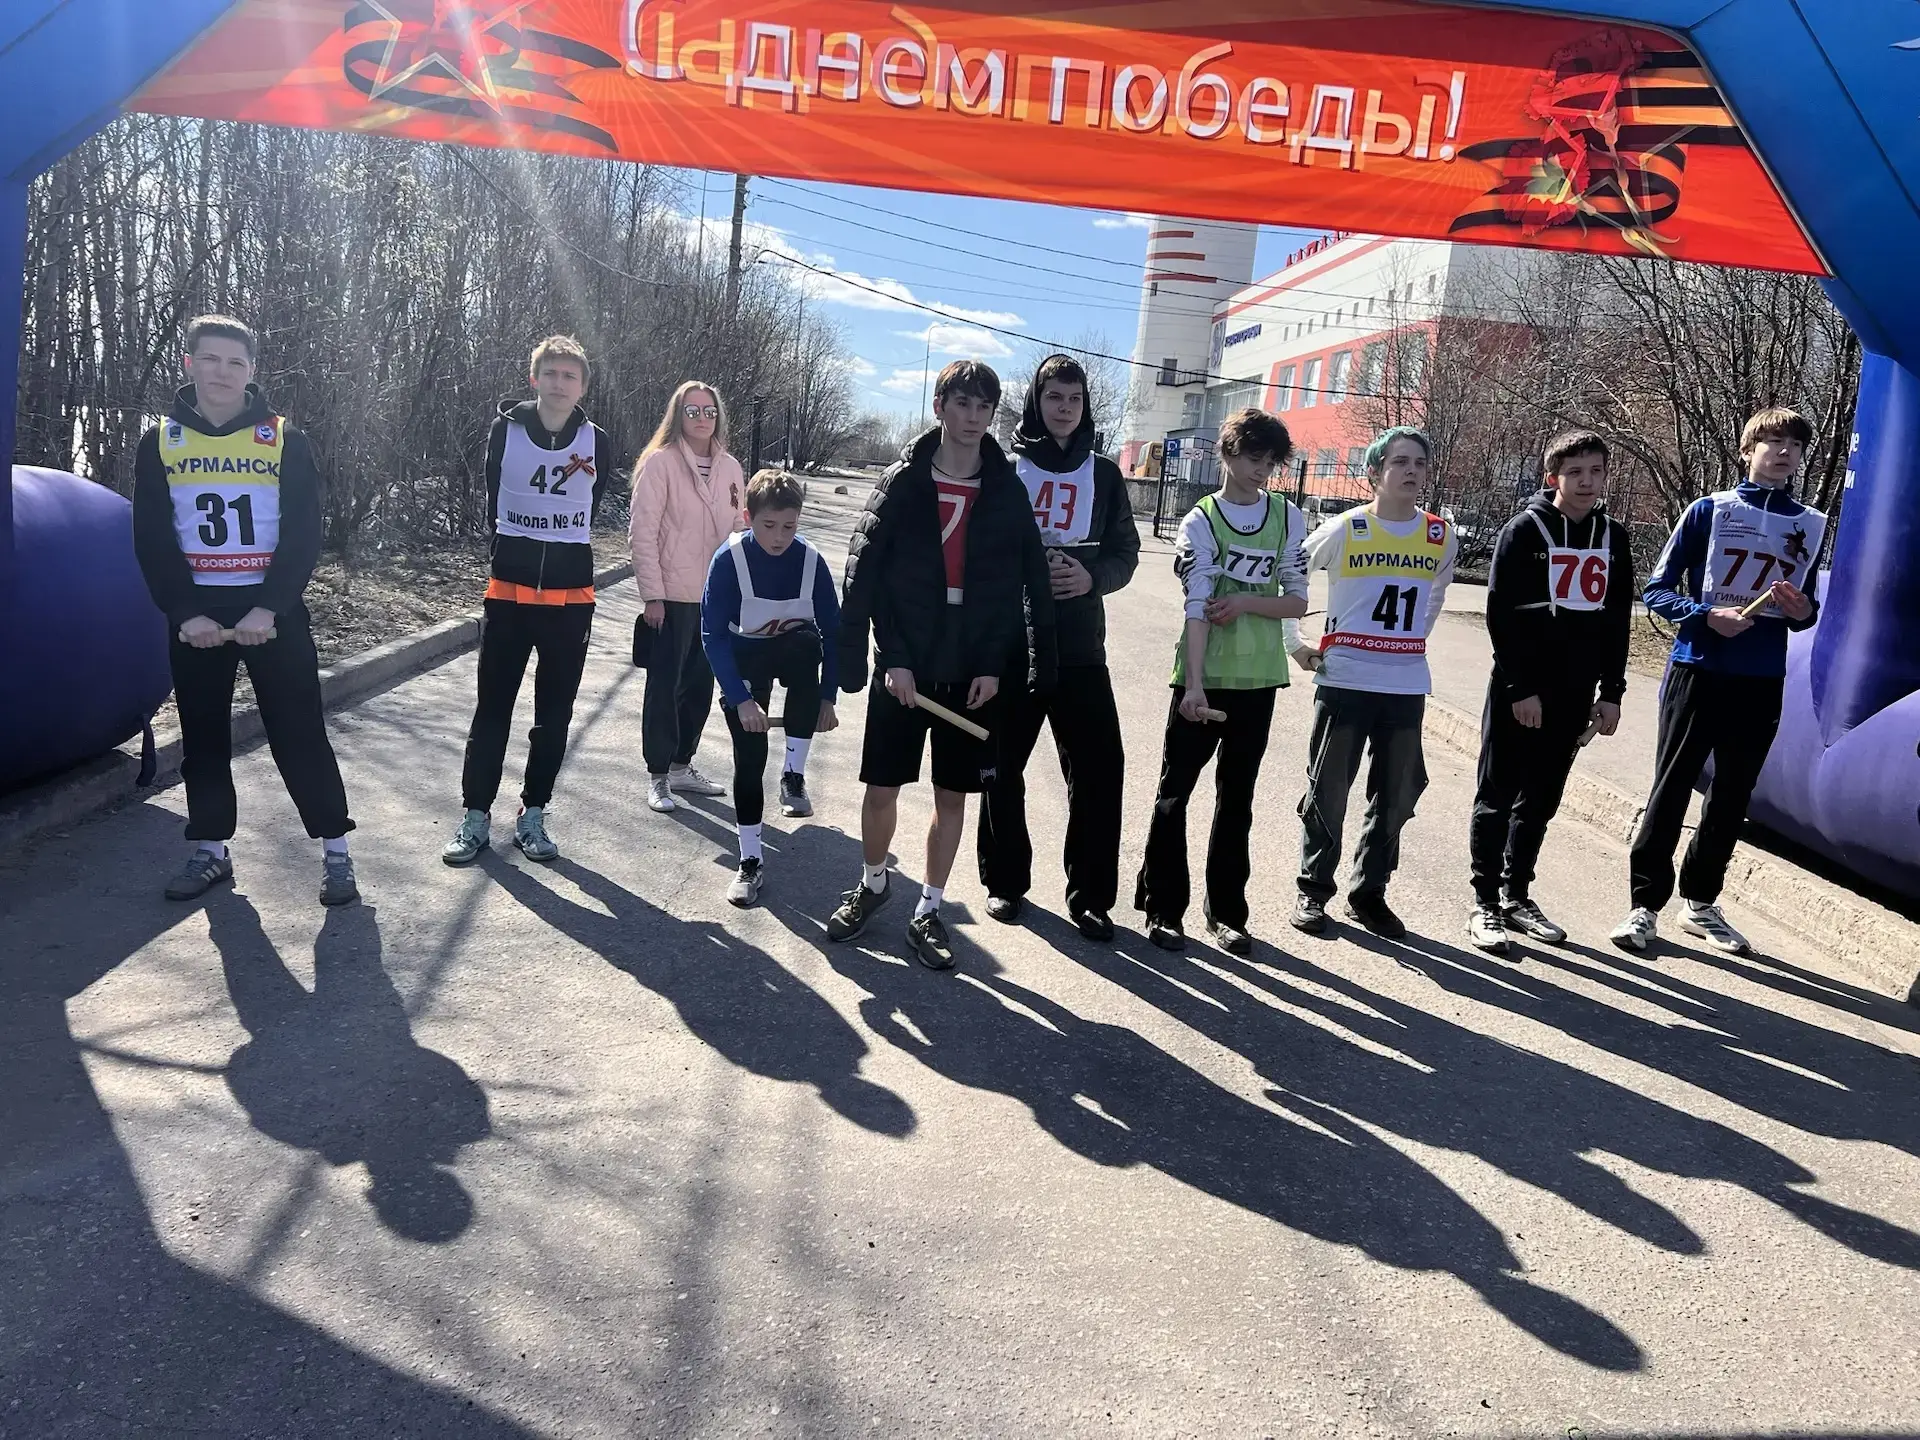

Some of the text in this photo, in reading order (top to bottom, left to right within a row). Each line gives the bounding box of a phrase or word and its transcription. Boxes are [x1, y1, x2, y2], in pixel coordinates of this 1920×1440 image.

[1047, 41, 1466, 168] победы!
[529, 465, 567, 495] 42
[195, 492, 255, 547] 31
[553, 514, 568, 529] №
[572, 511, 585, 527] 42
[1033, 481, 1077, 530] 43
[1226, 550, 1275, 577] 773
[1551, 555, 1607, 603] 76
[1372, 584, 1418, 631] 41
